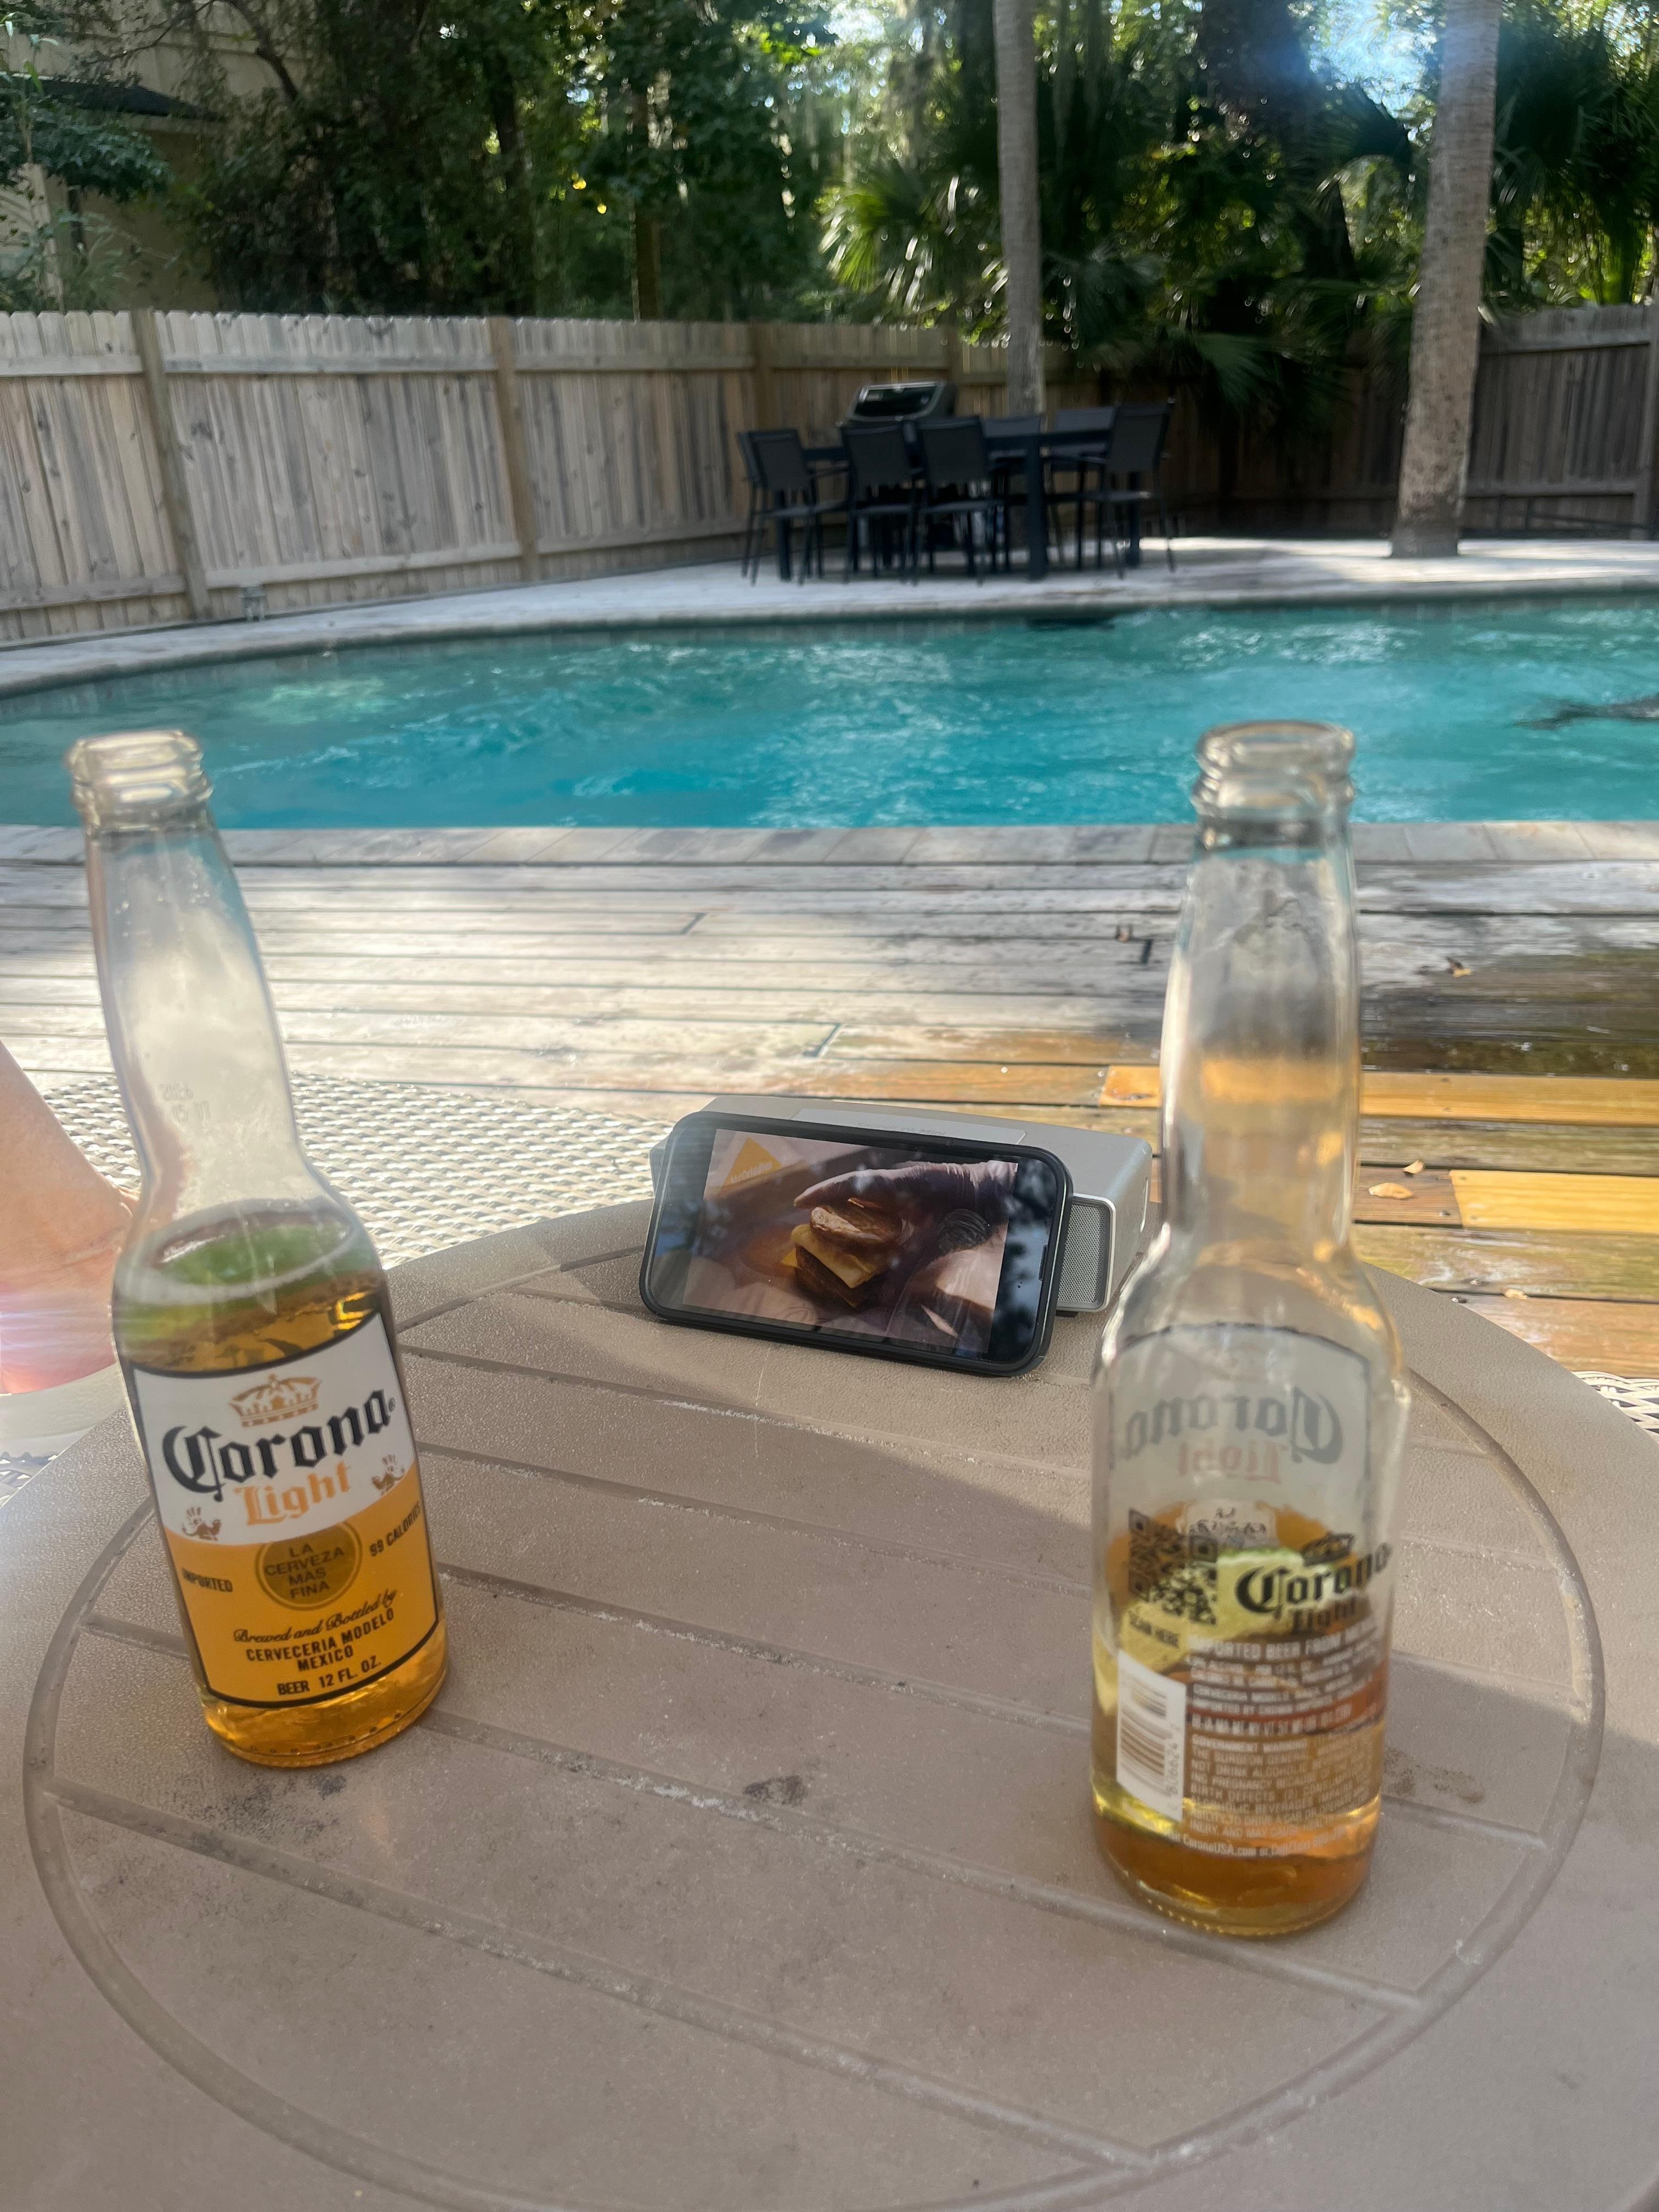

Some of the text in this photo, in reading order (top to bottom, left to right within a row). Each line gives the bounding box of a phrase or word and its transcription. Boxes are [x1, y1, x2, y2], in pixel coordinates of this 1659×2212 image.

[162, 1390, 391, 1503] Corona
[234, 1460, 352, 1527] Light
[264, 1546, 345, 1577] CERVEZA
[289, 1543, 313, 1559] LA
[181, 1567, 233, 1592] IMPORTED
[289, 1569, 328, 1586] MAS
[289, 1581, 330, 1599] FINA
[234, 1588, 399, 1643] Brewed and Bottled by
[246, 1607, 395, 1662] CERVECERIA MODELO
[297, 1645, 354, 1672] MEXICO
[276, 1655, 382, 1696] BEER 12 FL. OZ.
